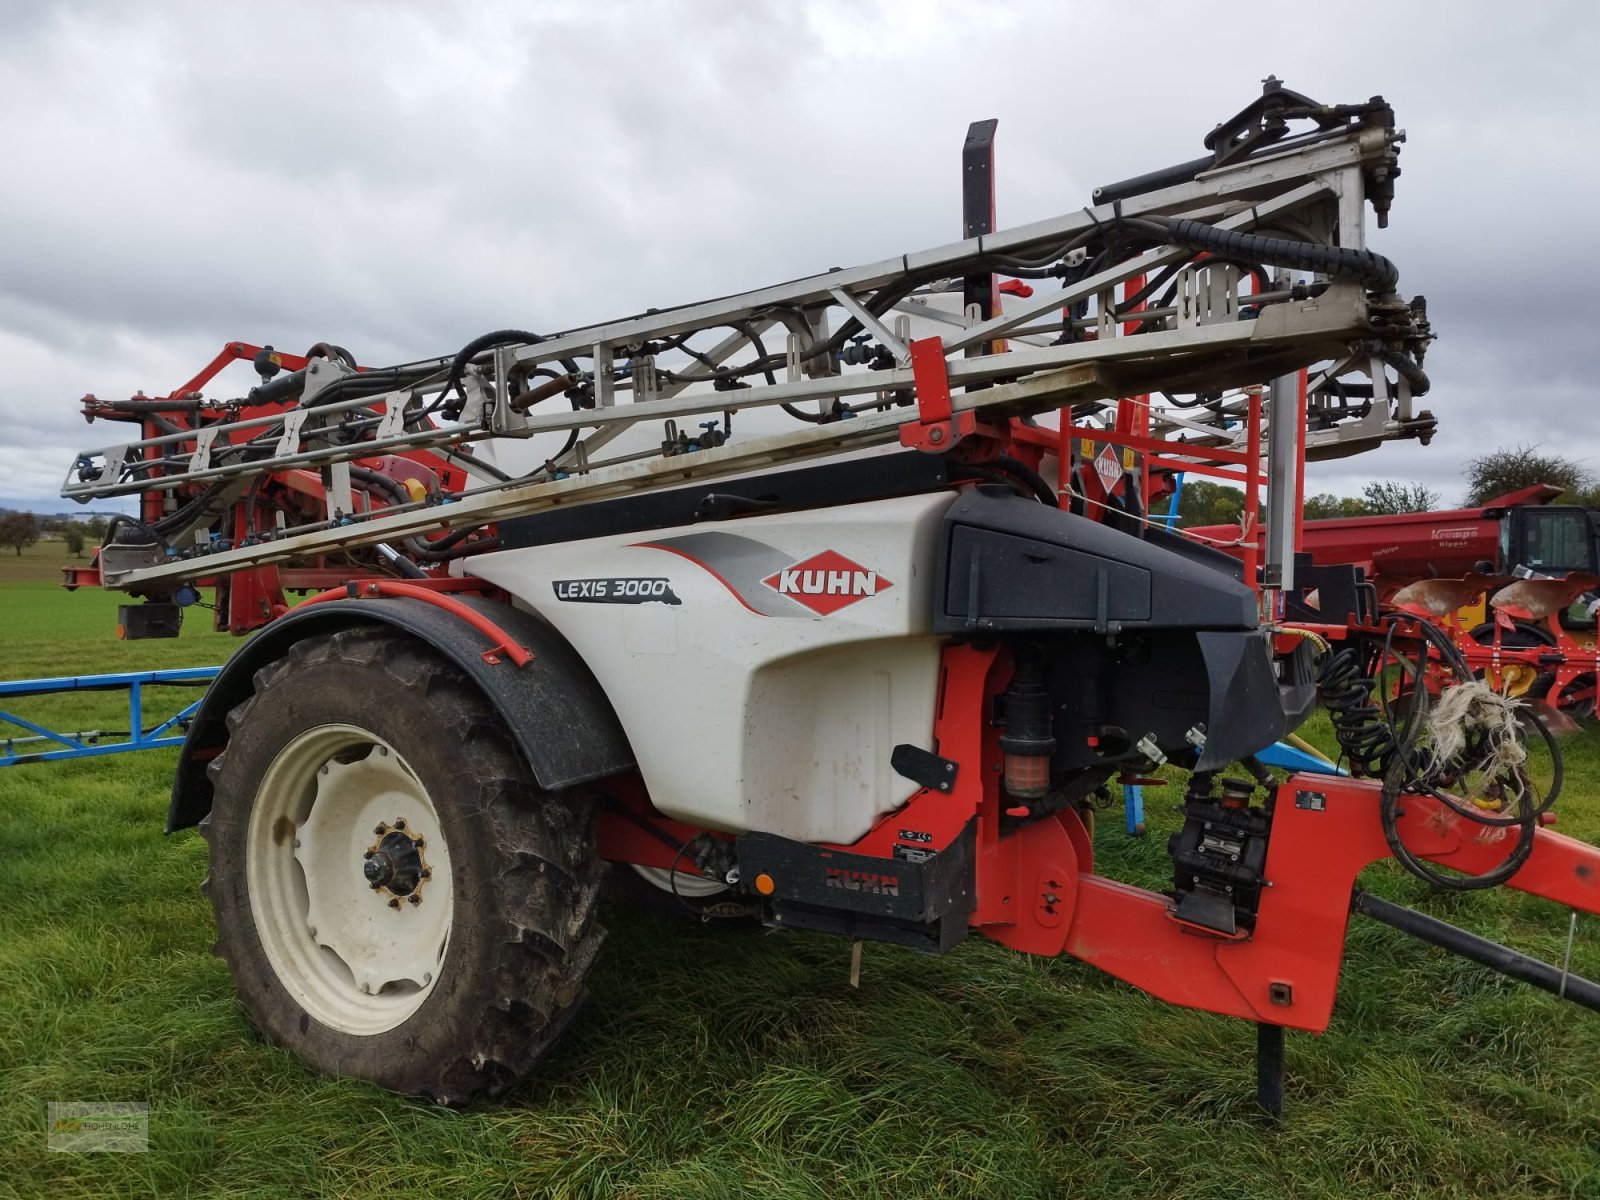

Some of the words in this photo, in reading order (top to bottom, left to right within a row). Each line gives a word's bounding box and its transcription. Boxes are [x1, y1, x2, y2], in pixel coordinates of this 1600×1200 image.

[1098, 456, 1120, 479] KUHN
[1431, 527, 1478, 540] Krampe
[559, 581, 608, 598] LEXIS
[613, 580, 667, 596] 3000
[778, 569, 878, 596] KUHN
